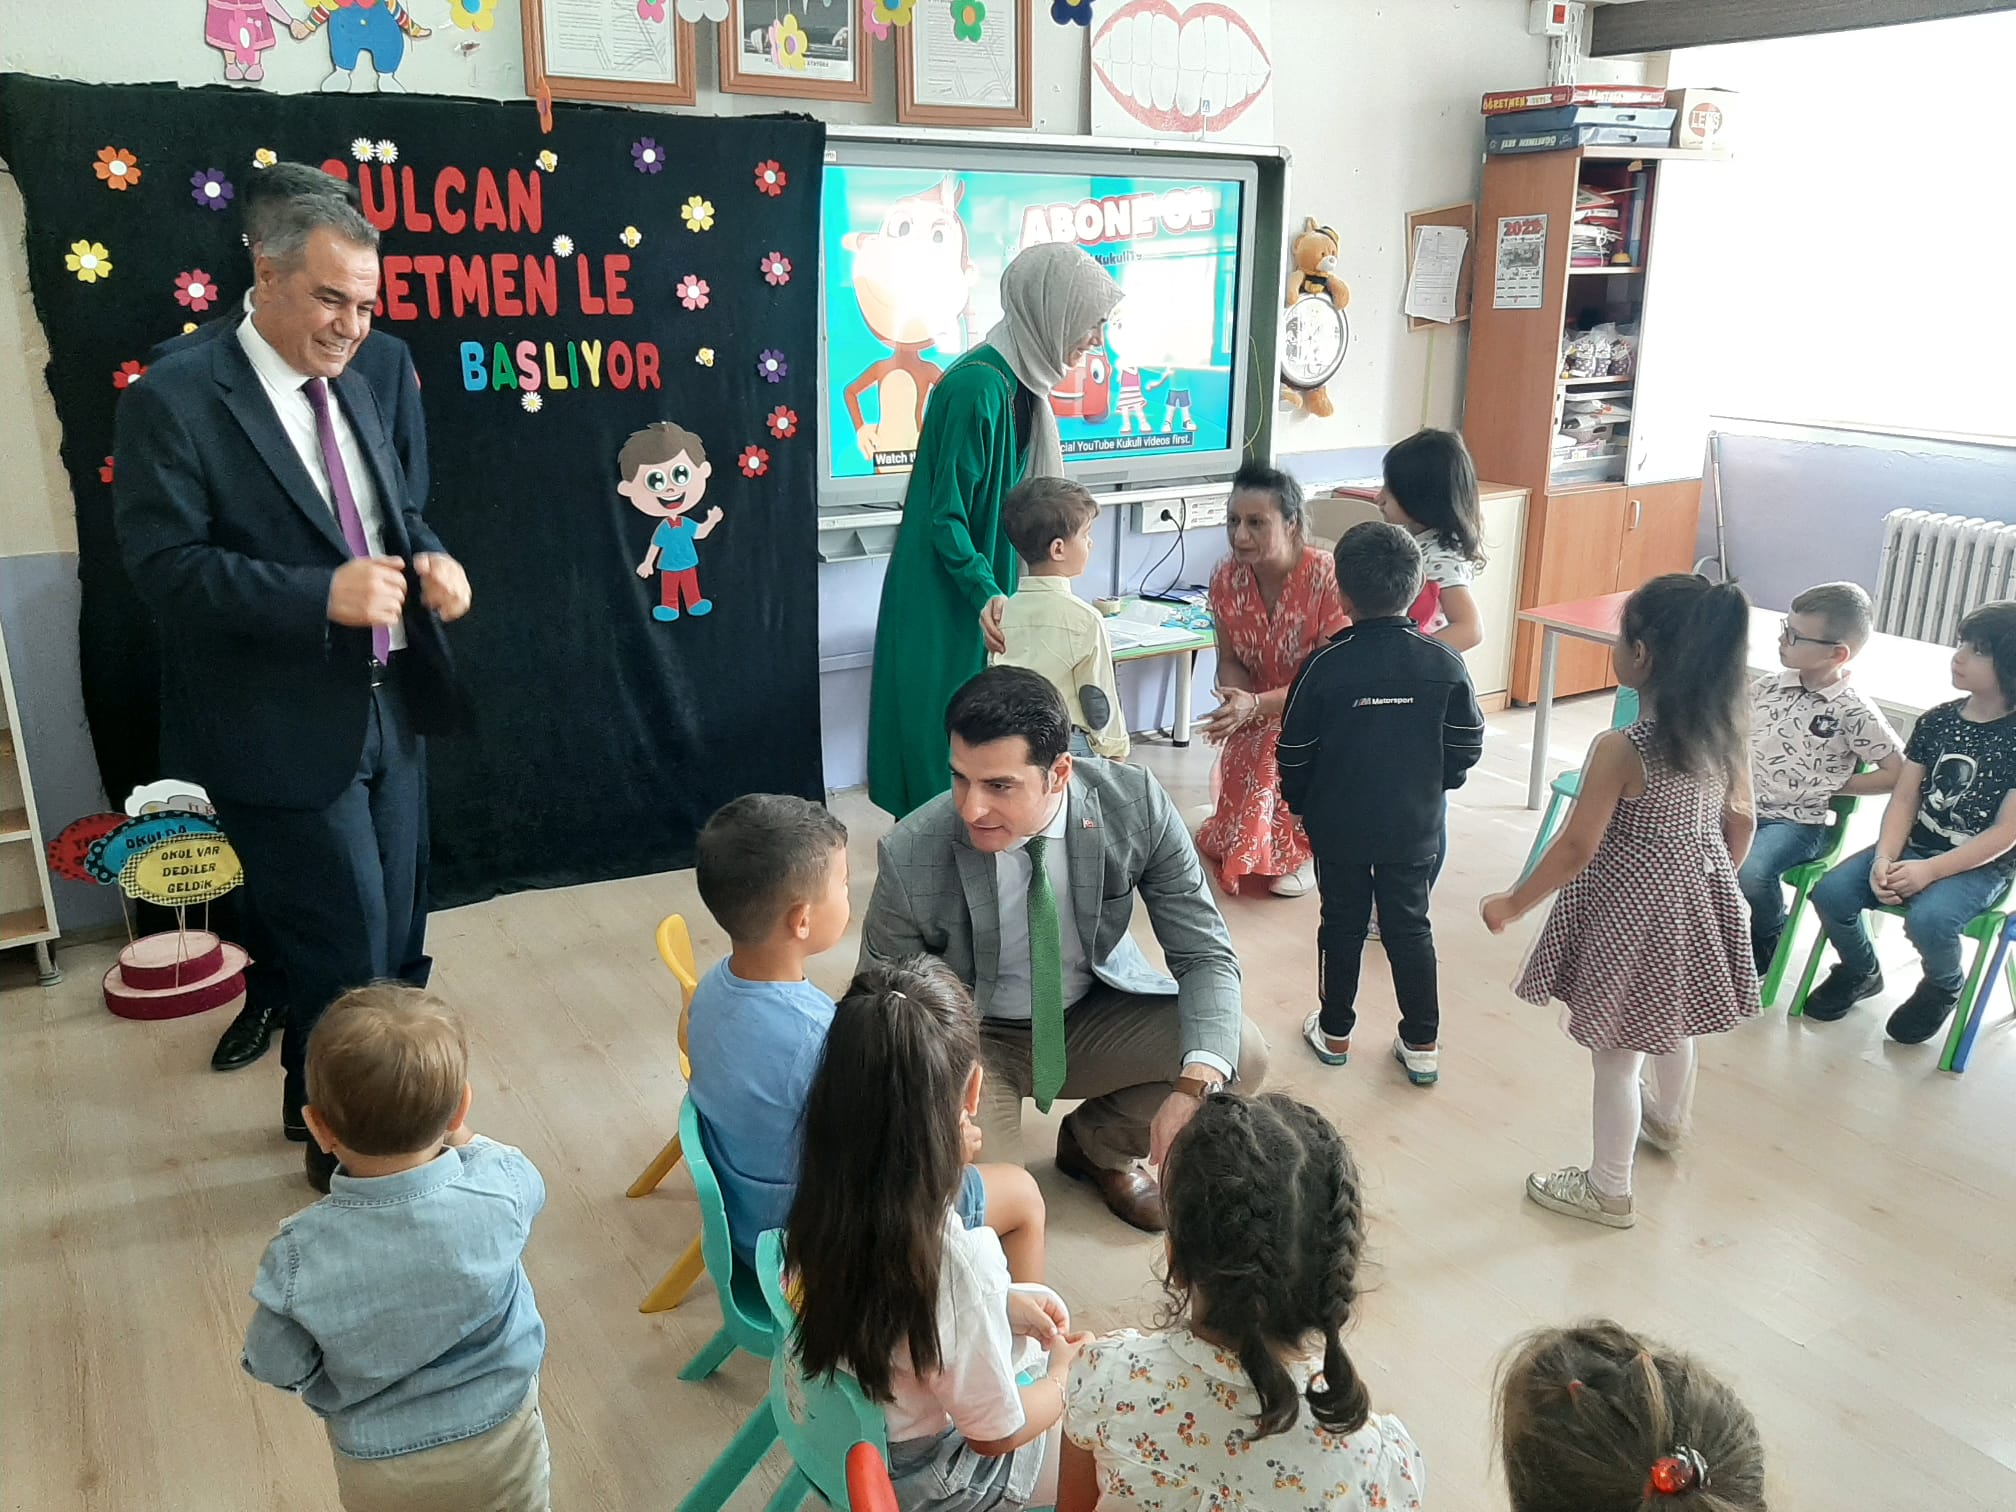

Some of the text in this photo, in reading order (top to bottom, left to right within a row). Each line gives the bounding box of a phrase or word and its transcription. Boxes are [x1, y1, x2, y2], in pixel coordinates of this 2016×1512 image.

[577, 253, 634, 316] LE
[875, 452, 908, 464] Watch
[1077, 439, 1115, 452] YouTube
[1116, 437, 1140, 449] Kukuli
[1143, 435, 1169, 446] videos
[1372, 697, 1414, 705] Motorsport
[161, 845, 220, 861] OKUL VAR
